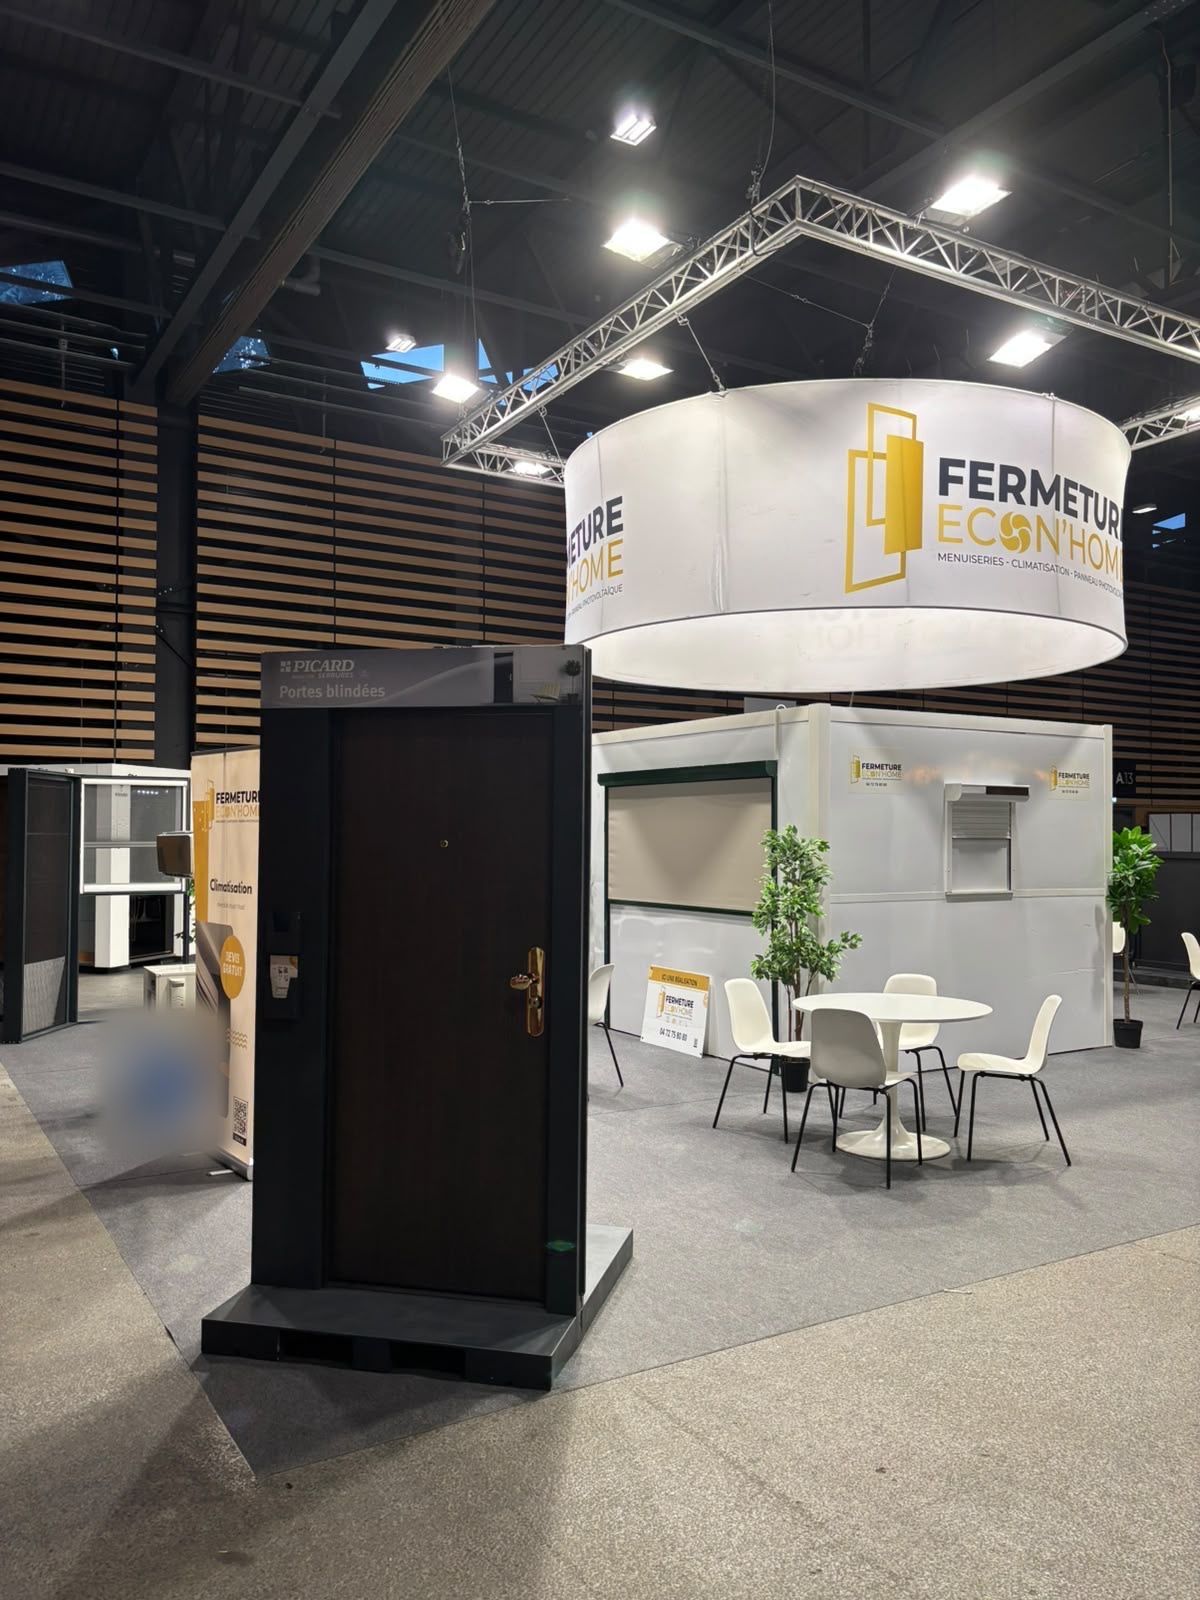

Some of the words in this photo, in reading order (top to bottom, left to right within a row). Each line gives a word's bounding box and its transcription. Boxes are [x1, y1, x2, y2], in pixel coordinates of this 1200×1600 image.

[937, 552, 1004, 566] MENUISERIES
[1011, 559, 1070, 576] CLIMATISATION
[292, 659, 355, 673] PICARD
[279, 685, 322, 698] Portes
[326, 683, 385, 697] blindées
[861, 763, 902, 771] FERMETURE
[1058, 772, 1090, 780] FERMETURE
[1115, 772, 1134, 785] A13
[210, 878, 253, 895] Climatisation
[665, 994, 694, 1009] FERMETURE
